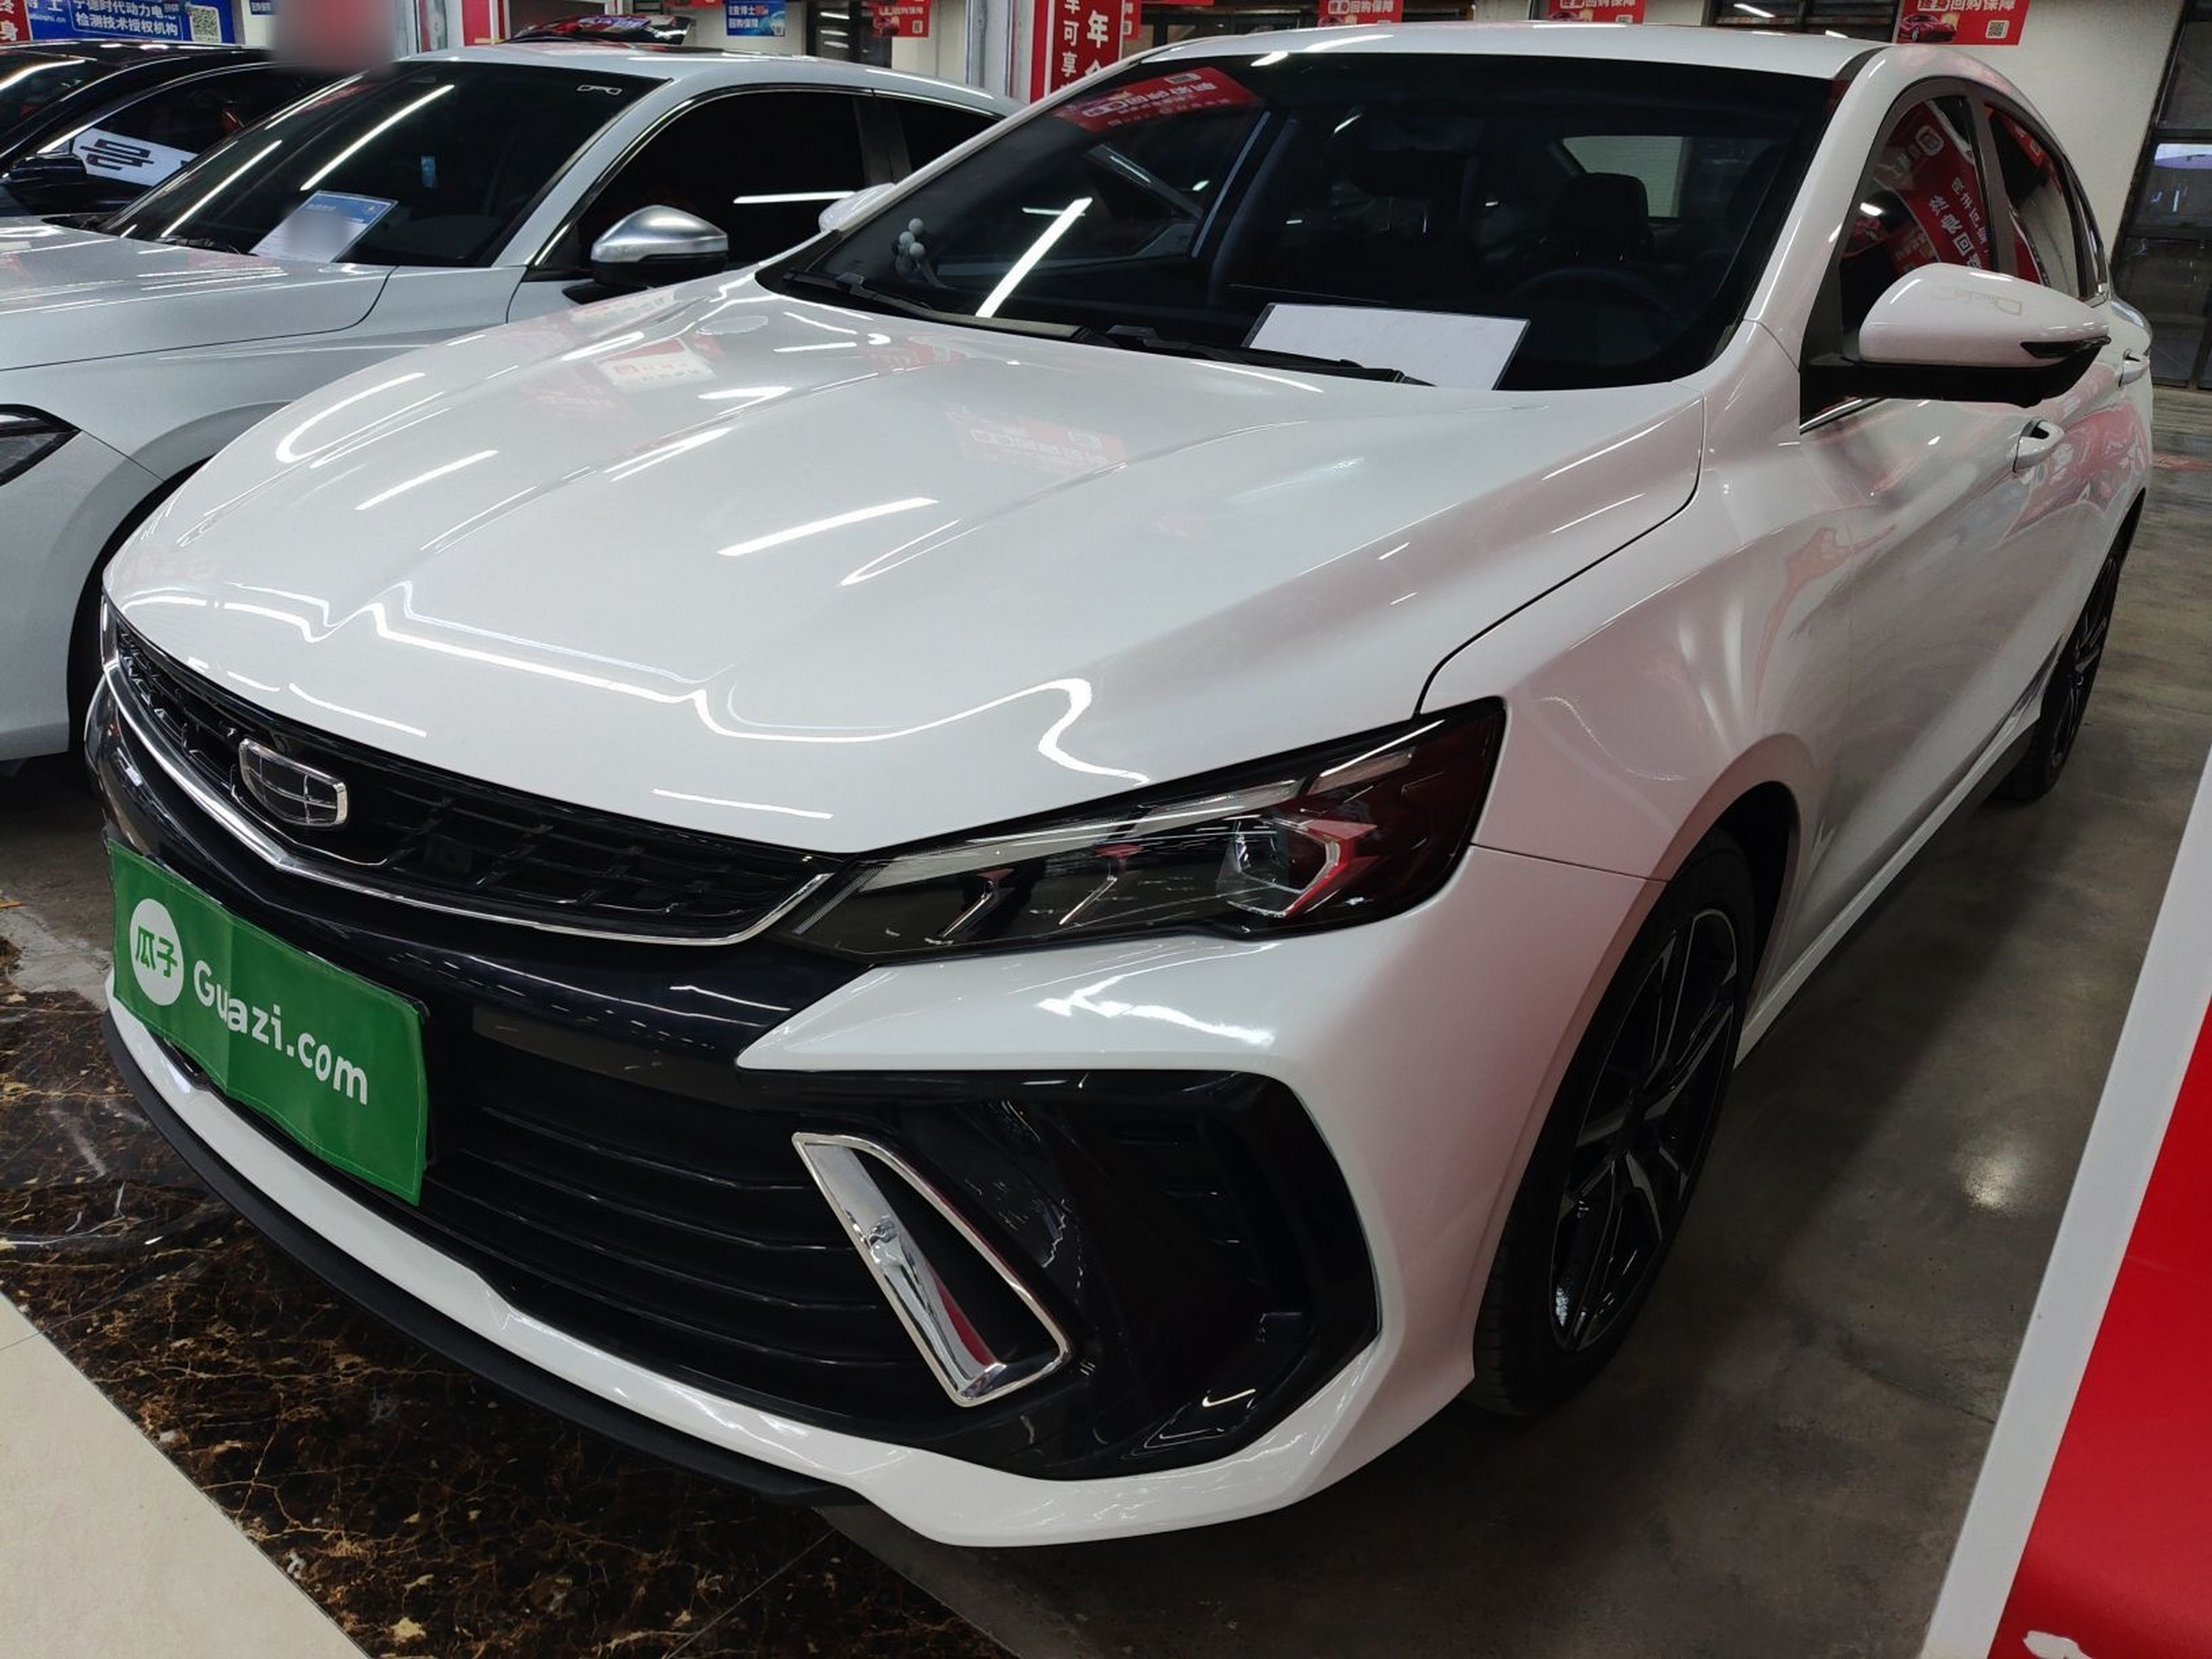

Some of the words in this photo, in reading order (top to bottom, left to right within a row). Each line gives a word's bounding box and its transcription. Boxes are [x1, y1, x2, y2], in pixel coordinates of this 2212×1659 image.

[75, 12, 179, 36] 检测技术授权机构
[135, 925, 177, 978] 瓜子
[194, 960, 368, 1105] Guazi.com
